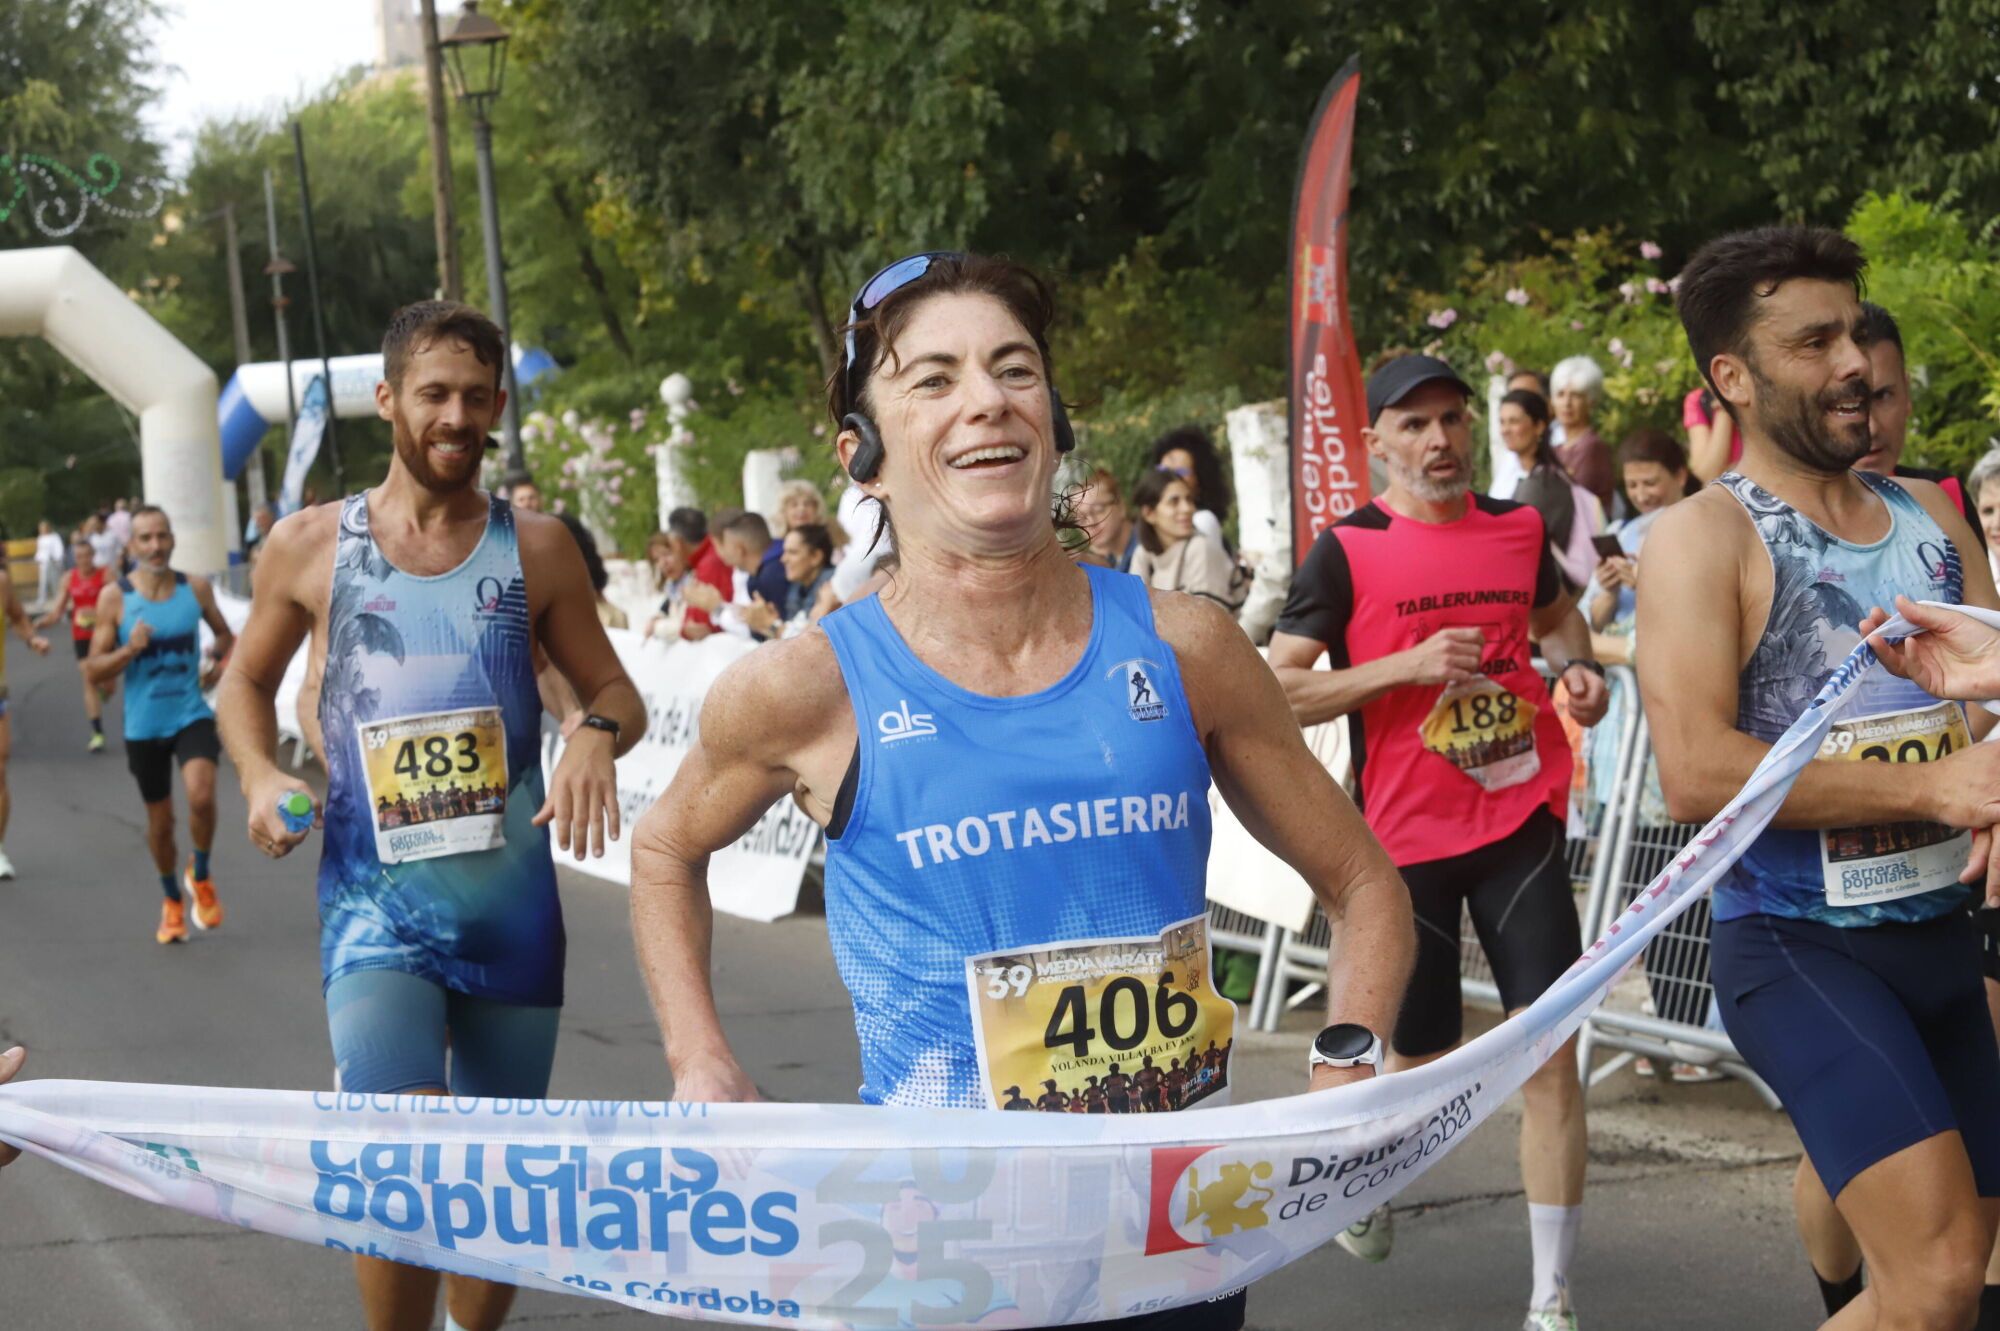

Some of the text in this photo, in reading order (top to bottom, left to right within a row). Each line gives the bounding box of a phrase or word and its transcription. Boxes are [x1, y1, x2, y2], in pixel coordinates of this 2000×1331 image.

[1314, 353, 1358, 518] eportes
[1395, 590, 1529, 617] TABLERUNNERS
[1448, 691, 1519, 733] 188
[393, 732, 480, 780] 483
[896, 791, 1189, 870] TROTASIERRA
[1841, 861, 1907, 880] carreras
[1843, 867, 1919, 892] populares
[986, 964, 1033, 1000] 39
[1036, 957, 1095, 976] MEDIA
[1044, 971, 1198, 1058] 406
[1051, 1054, 1106, 1073] YOLANDA
[1108, 1045, 1163, 1062] VILLALBA
[1279, 1102, 1472, 1221] de Córdoba
[816, 1218, 994, 1326] 25
